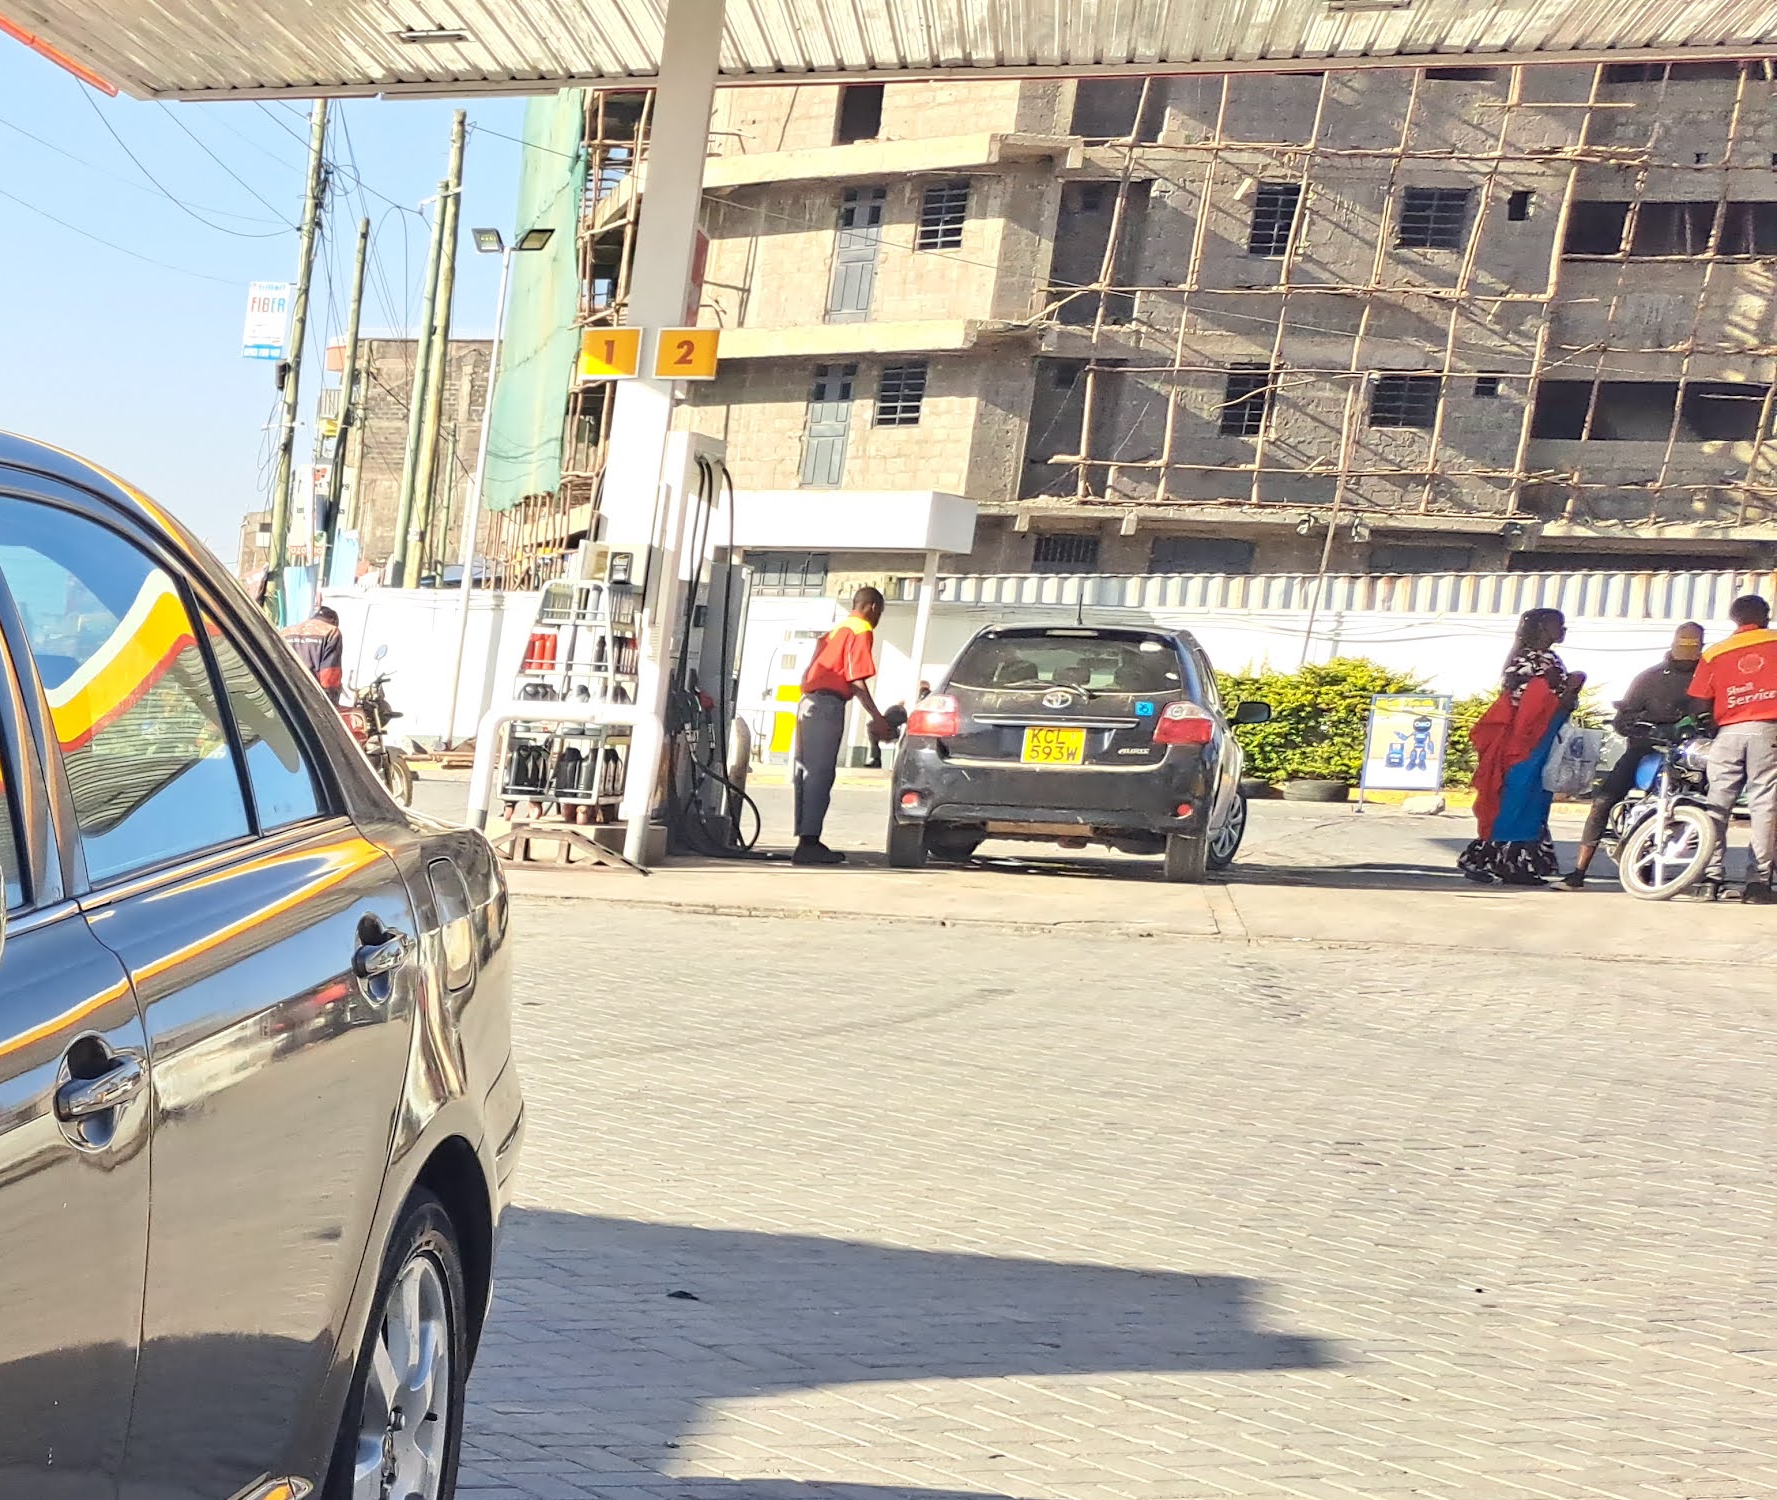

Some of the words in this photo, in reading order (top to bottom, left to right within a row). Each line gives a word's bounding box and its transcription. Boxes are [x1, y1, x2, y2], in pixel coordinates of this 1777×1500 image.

[604, 340, 615, 364] 1
[673, 340, 695, 365] 2
[1727, 689, 1777, 709] Service
[1030, 728, 1066, 745] KCL
[1029, 745, 1078, 761] 593W
